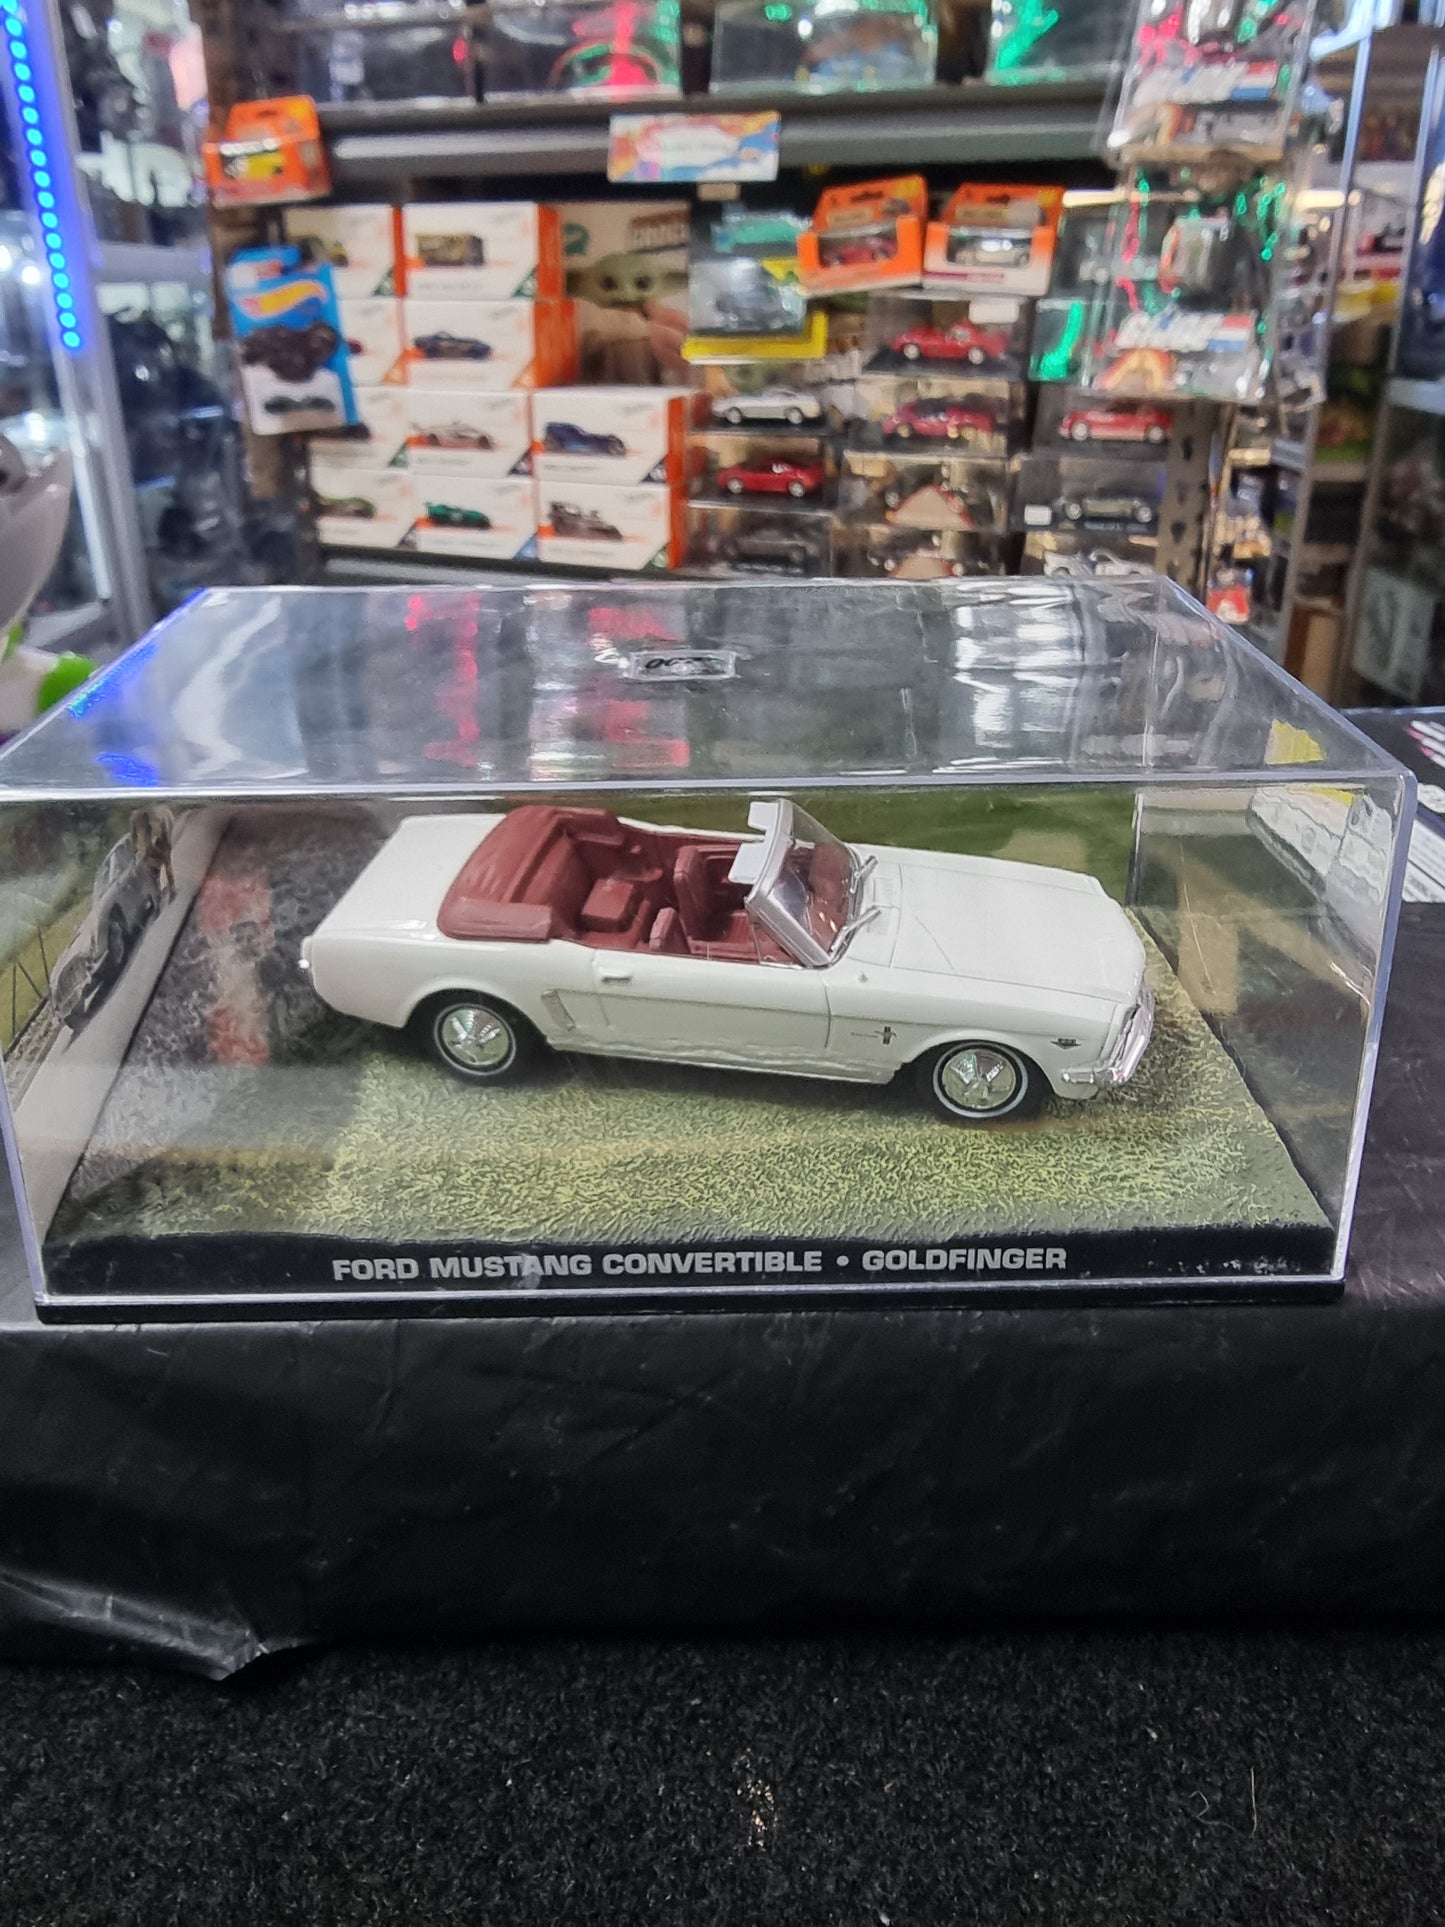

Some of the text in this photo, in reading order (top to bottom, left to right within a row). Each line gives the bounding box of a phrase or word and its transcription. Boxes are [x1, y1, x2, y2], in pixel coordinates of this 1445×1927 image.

[332, 1248, 1067, 1281] FORD MUSTANG CONVERTIBLE GOLDFINGER
